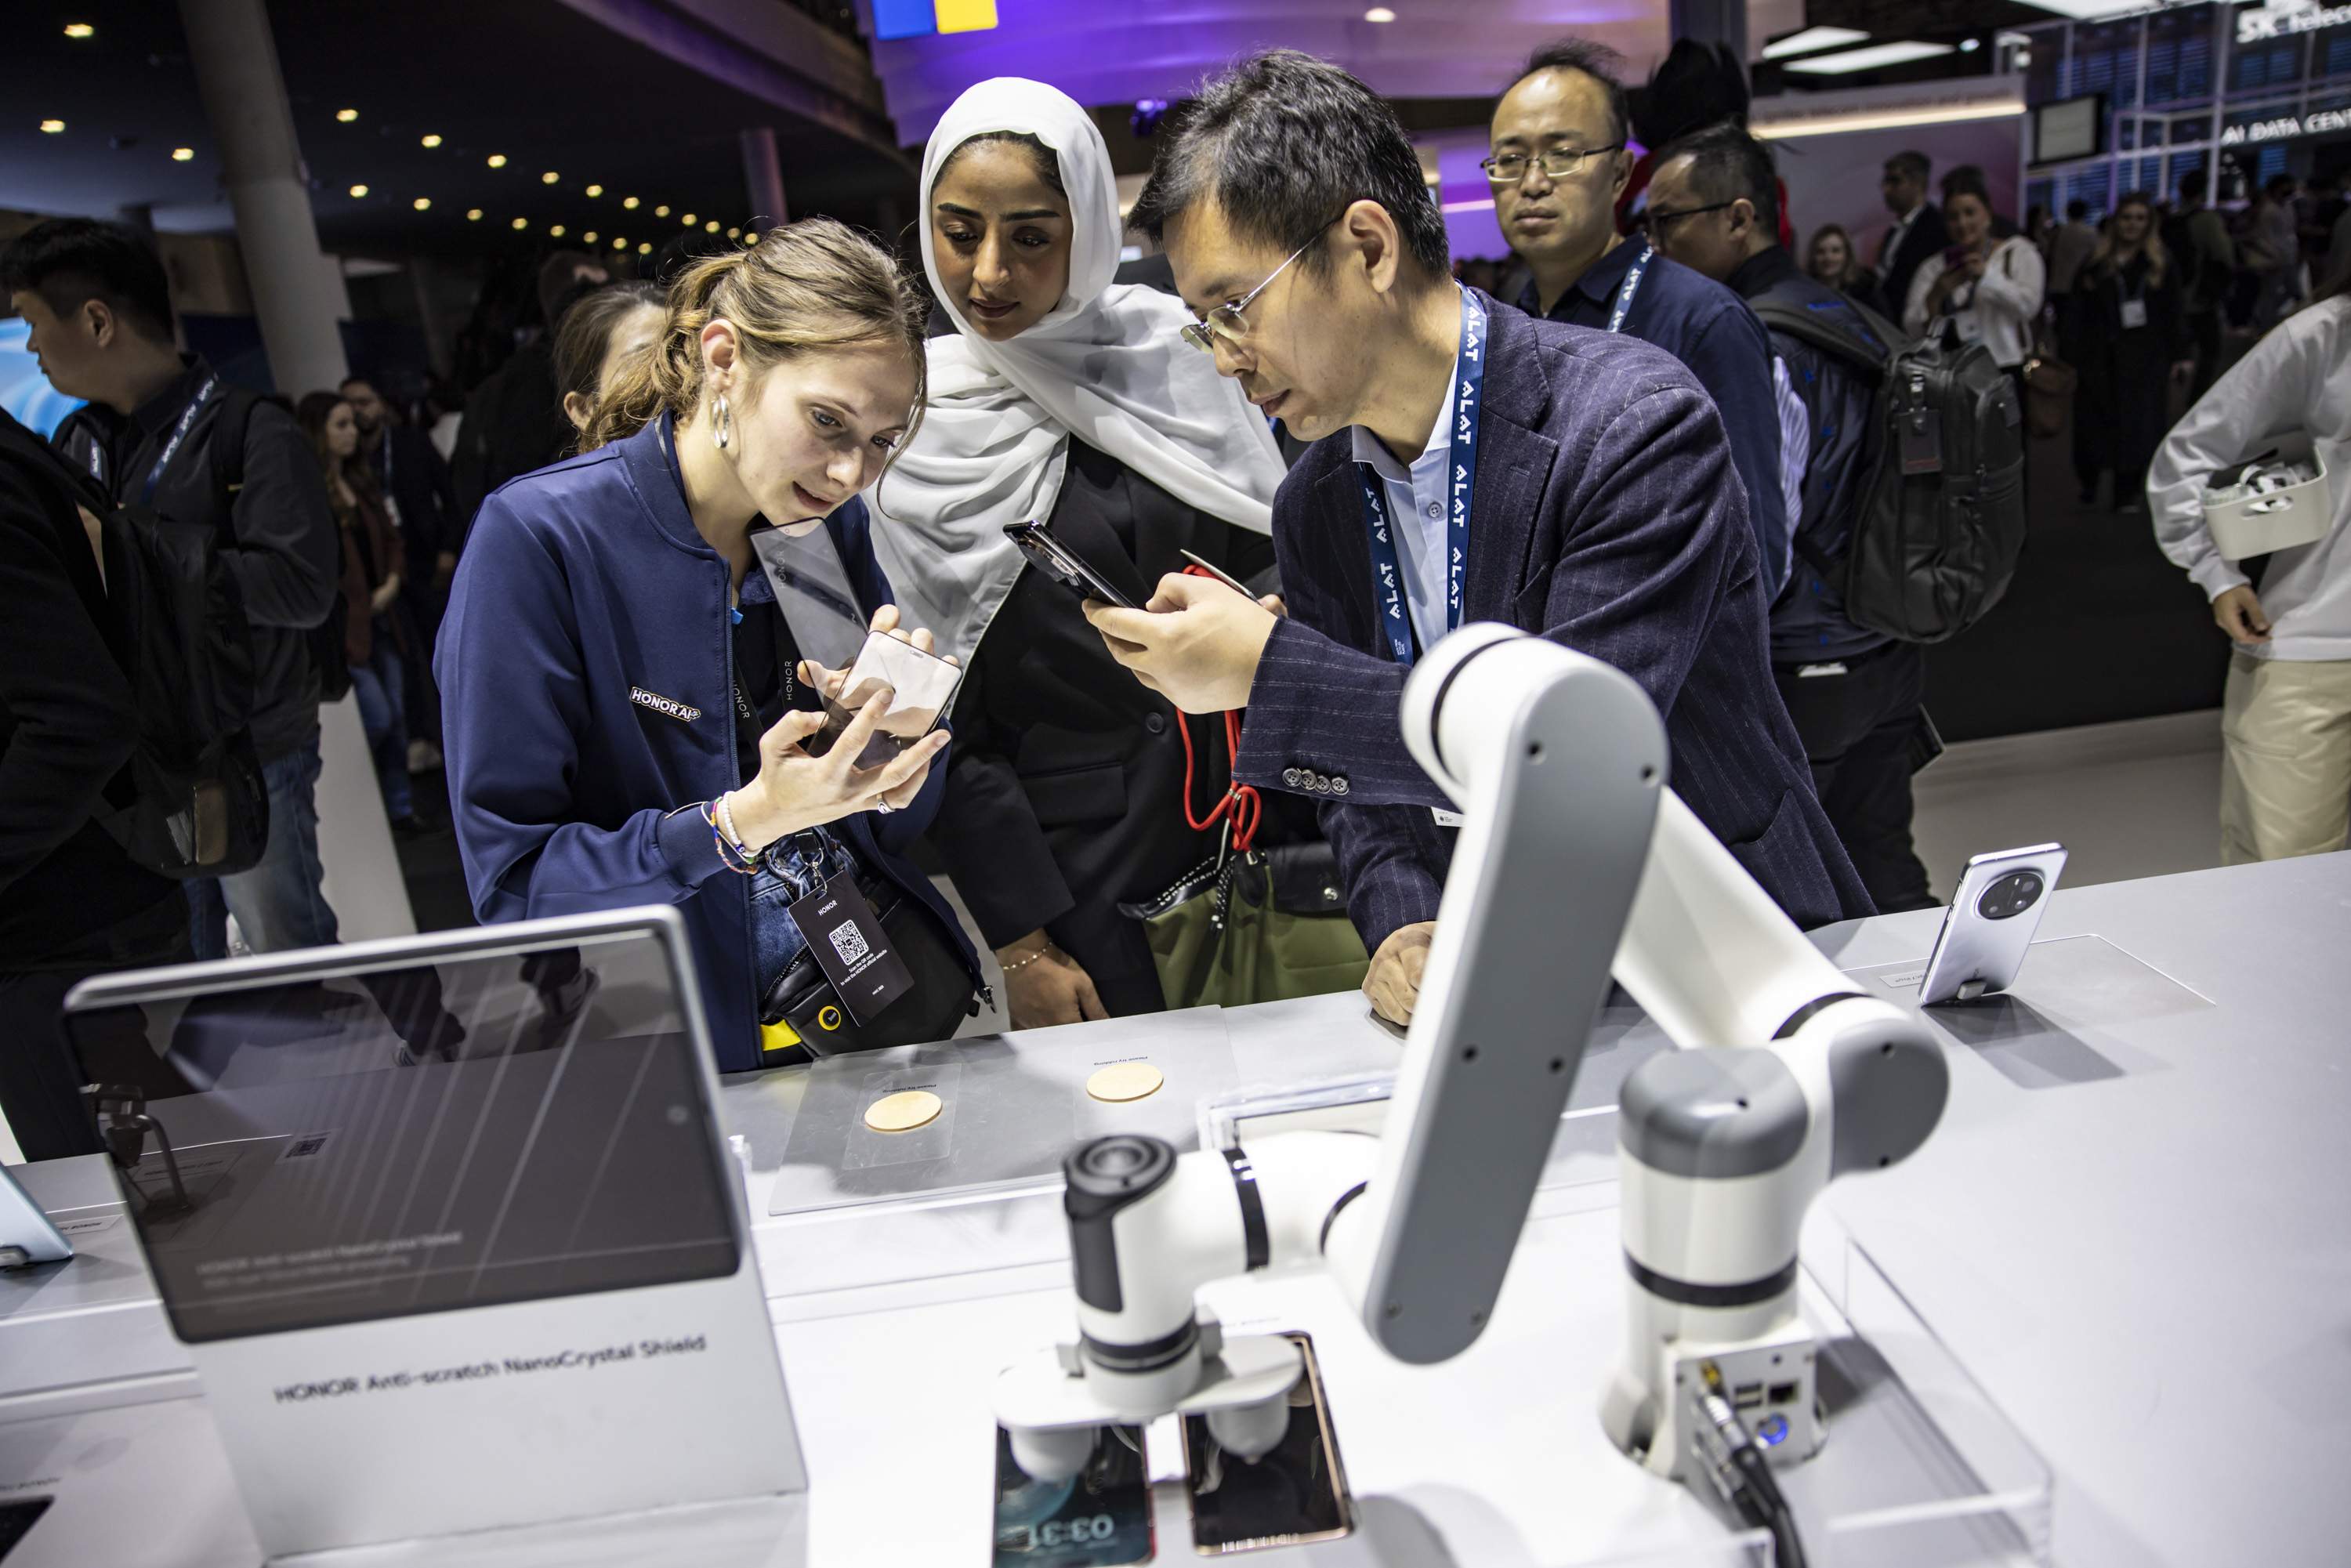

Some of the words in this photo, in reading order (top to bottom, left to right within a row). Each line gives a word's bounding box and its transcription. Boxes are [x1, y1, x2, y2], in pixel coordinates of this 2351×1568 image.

[2236, 7, 2277, 43] SK
[2220, 125, 2245, 145] AI
[2248, 118, 2301, 142] DATA
[1465, 306, 1481, 361] ALAT
[1458, 380, 1474, 444] ALAT
[1364, 487, 1389, 543] ALAT
[1453, 464, 1468, 527] ALAT
[1379, 563, 1402, 619] ALAT
[1450, 546, 1462, 609] ALAT
[632, 689, 678, 715] HONOR
[784, 661, 793, 701] HONOR
[817, 900, 838, 916] HONOR
[855, 964, 868, 975] HONOR
[273, 1377, 359, 1403] HONOR
[367, 1360, 499, 1391] Anti-scratch
[503, 1342, 635, 1374] NanoCrystal
[639, 1334, 706, 1358] Shield
